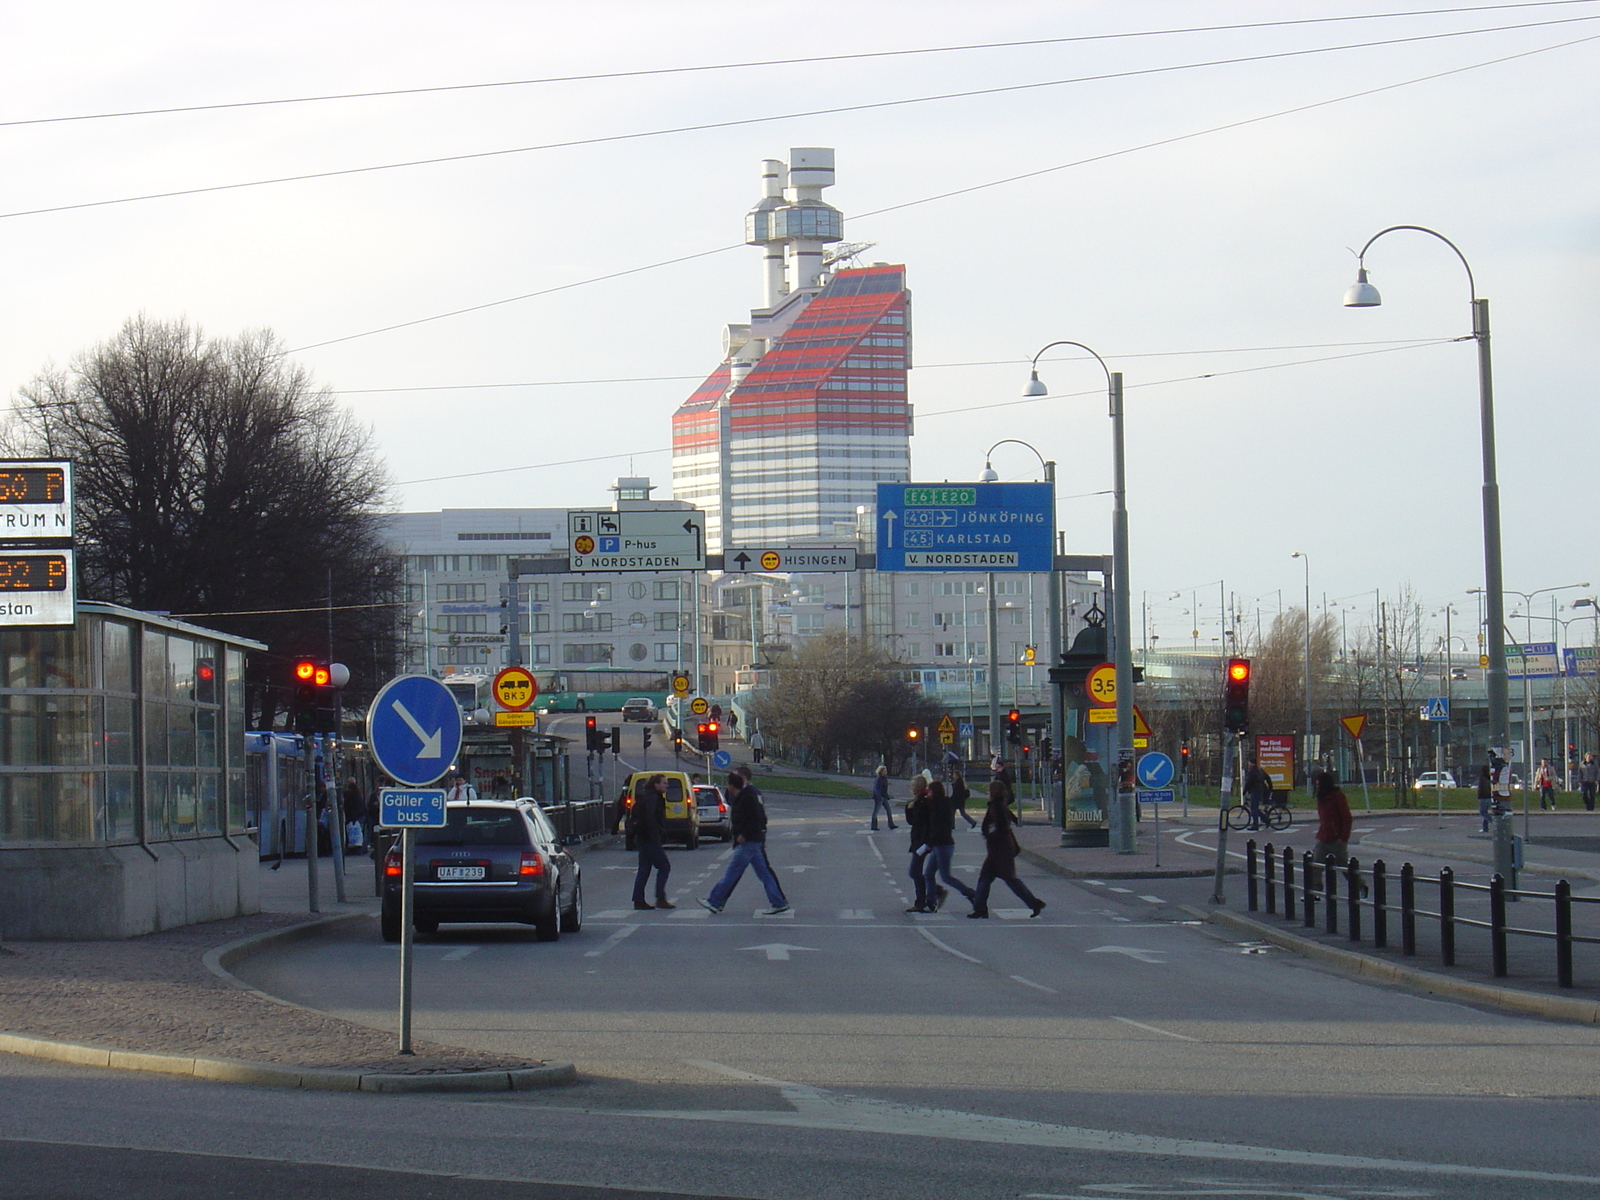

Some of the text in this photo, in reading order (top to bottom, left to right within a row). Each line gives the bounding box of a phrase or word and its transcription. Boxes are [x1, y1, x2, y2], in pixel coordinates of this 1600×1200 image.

[911, 492, 969, 502] E6 E20
[0, 514, 66, 527] RUM N
[910, 511, 1044, 524] 40 JÖNKÖPING
[910, 534, 1011, 544] 45 KARLSTAD
[605, 540, 613, 550] P
[624, 540, 657, 550] P-hus
[574, 555, 679, 567] Ö NORDSTADEN
[784, 555, 847, 566] HISINGEN
[909, 554, 1015, 564] V. NORDSTADEN
[384, 795, 443, 810] Gäller ej
[397, 810, 429, 822] buss
[439, 868, 483, 876] UAF 239
